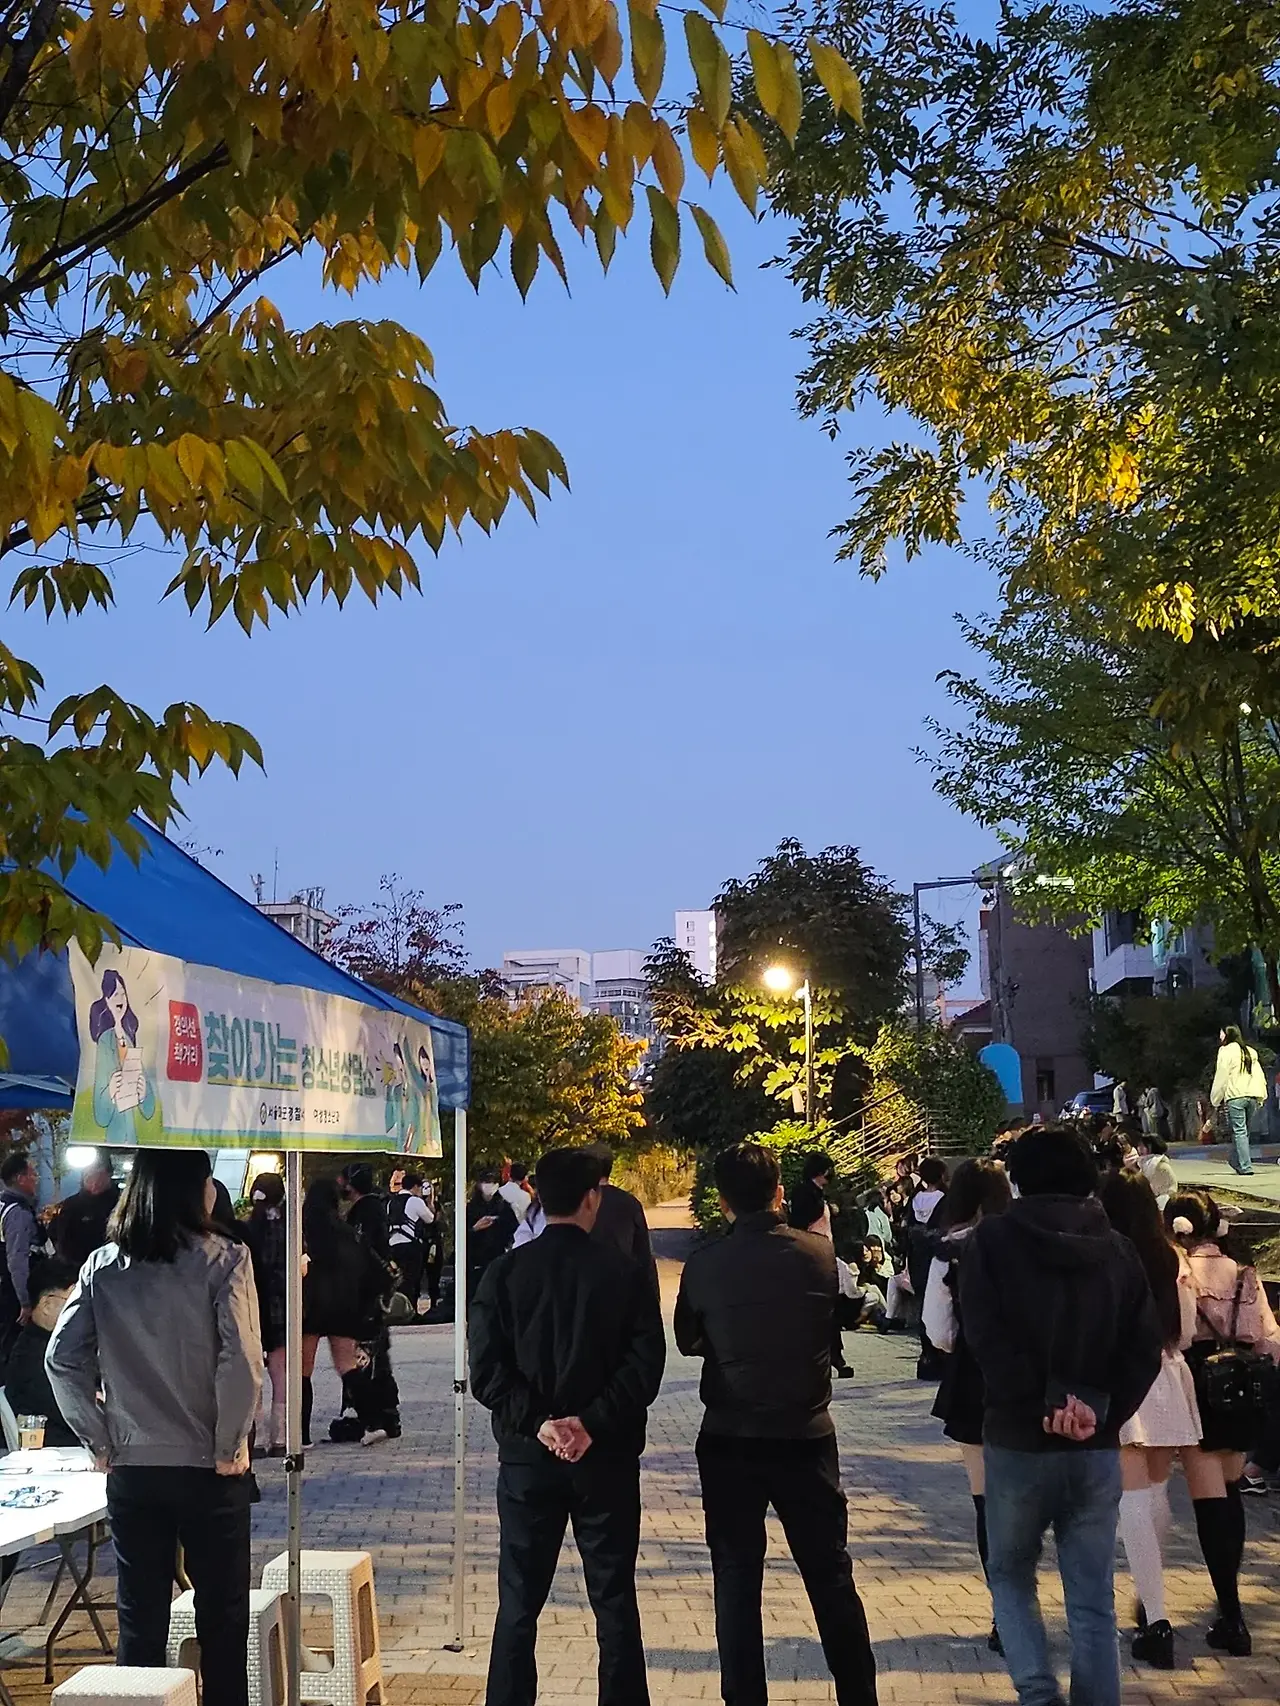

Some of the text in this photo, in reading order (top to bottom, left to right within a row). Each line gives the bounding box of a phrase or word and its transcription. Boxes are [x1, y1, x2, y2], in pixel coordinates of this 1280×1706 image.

[173, 1015, 197, 1038] 경의선
[173, 1042, 198, 1066] 책거리
[204, 1011, 297, 1085] 찾아가는
